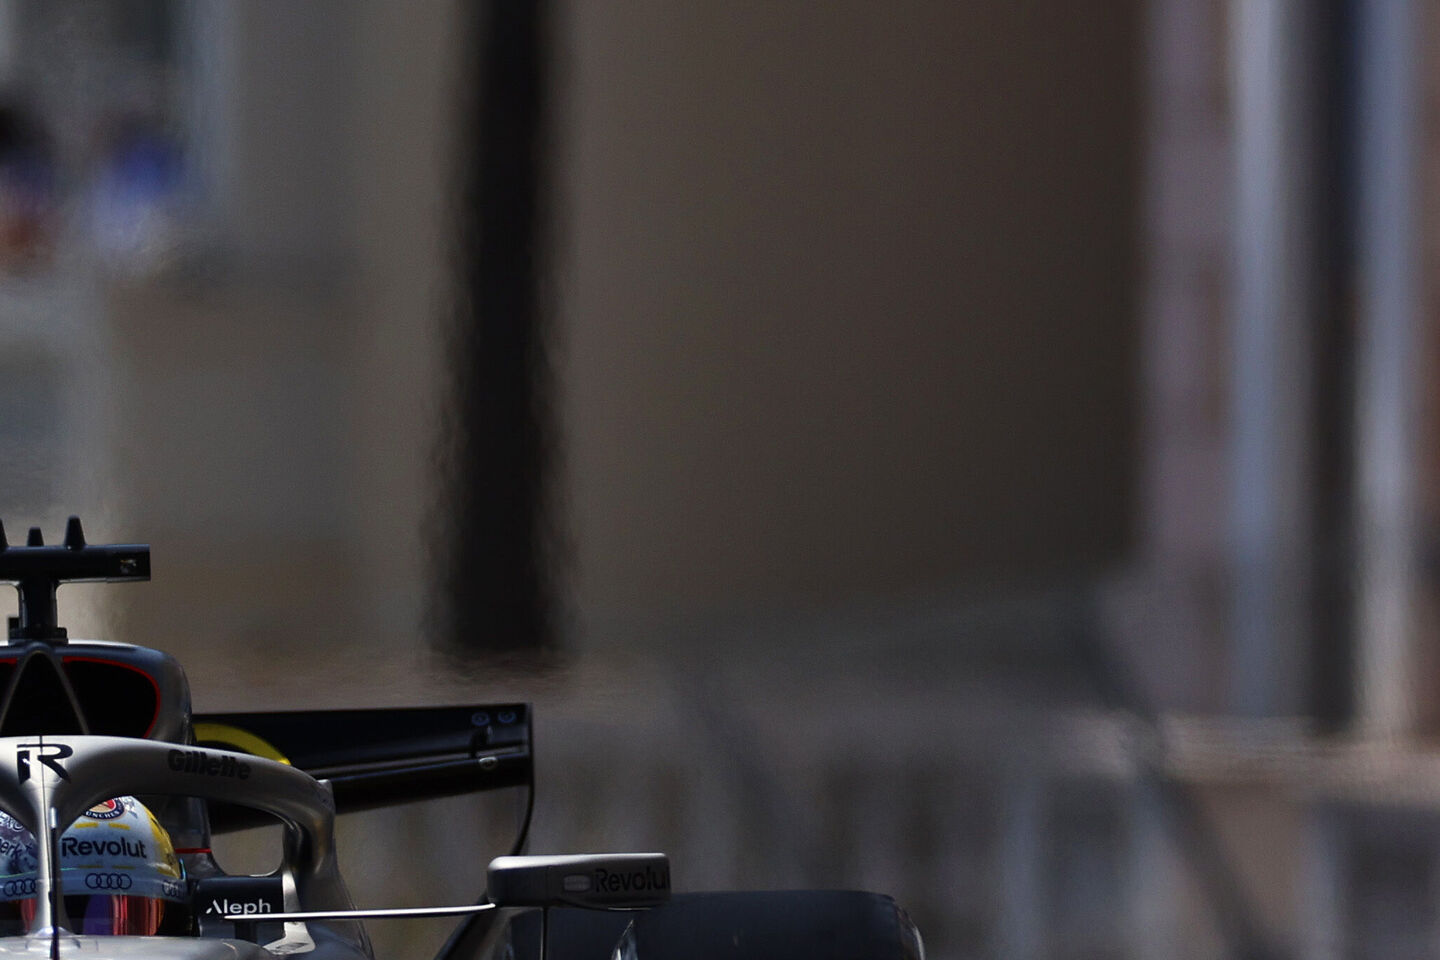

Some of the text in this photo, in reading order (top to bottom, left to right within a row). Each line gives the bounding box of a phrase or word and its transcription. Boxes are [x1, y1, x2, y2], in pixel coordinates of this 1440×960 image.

[167, 749, 252, 780] Gillette
[62, 837, 147, 858] Revolut
[206, 899, 271, 915] Aleph
